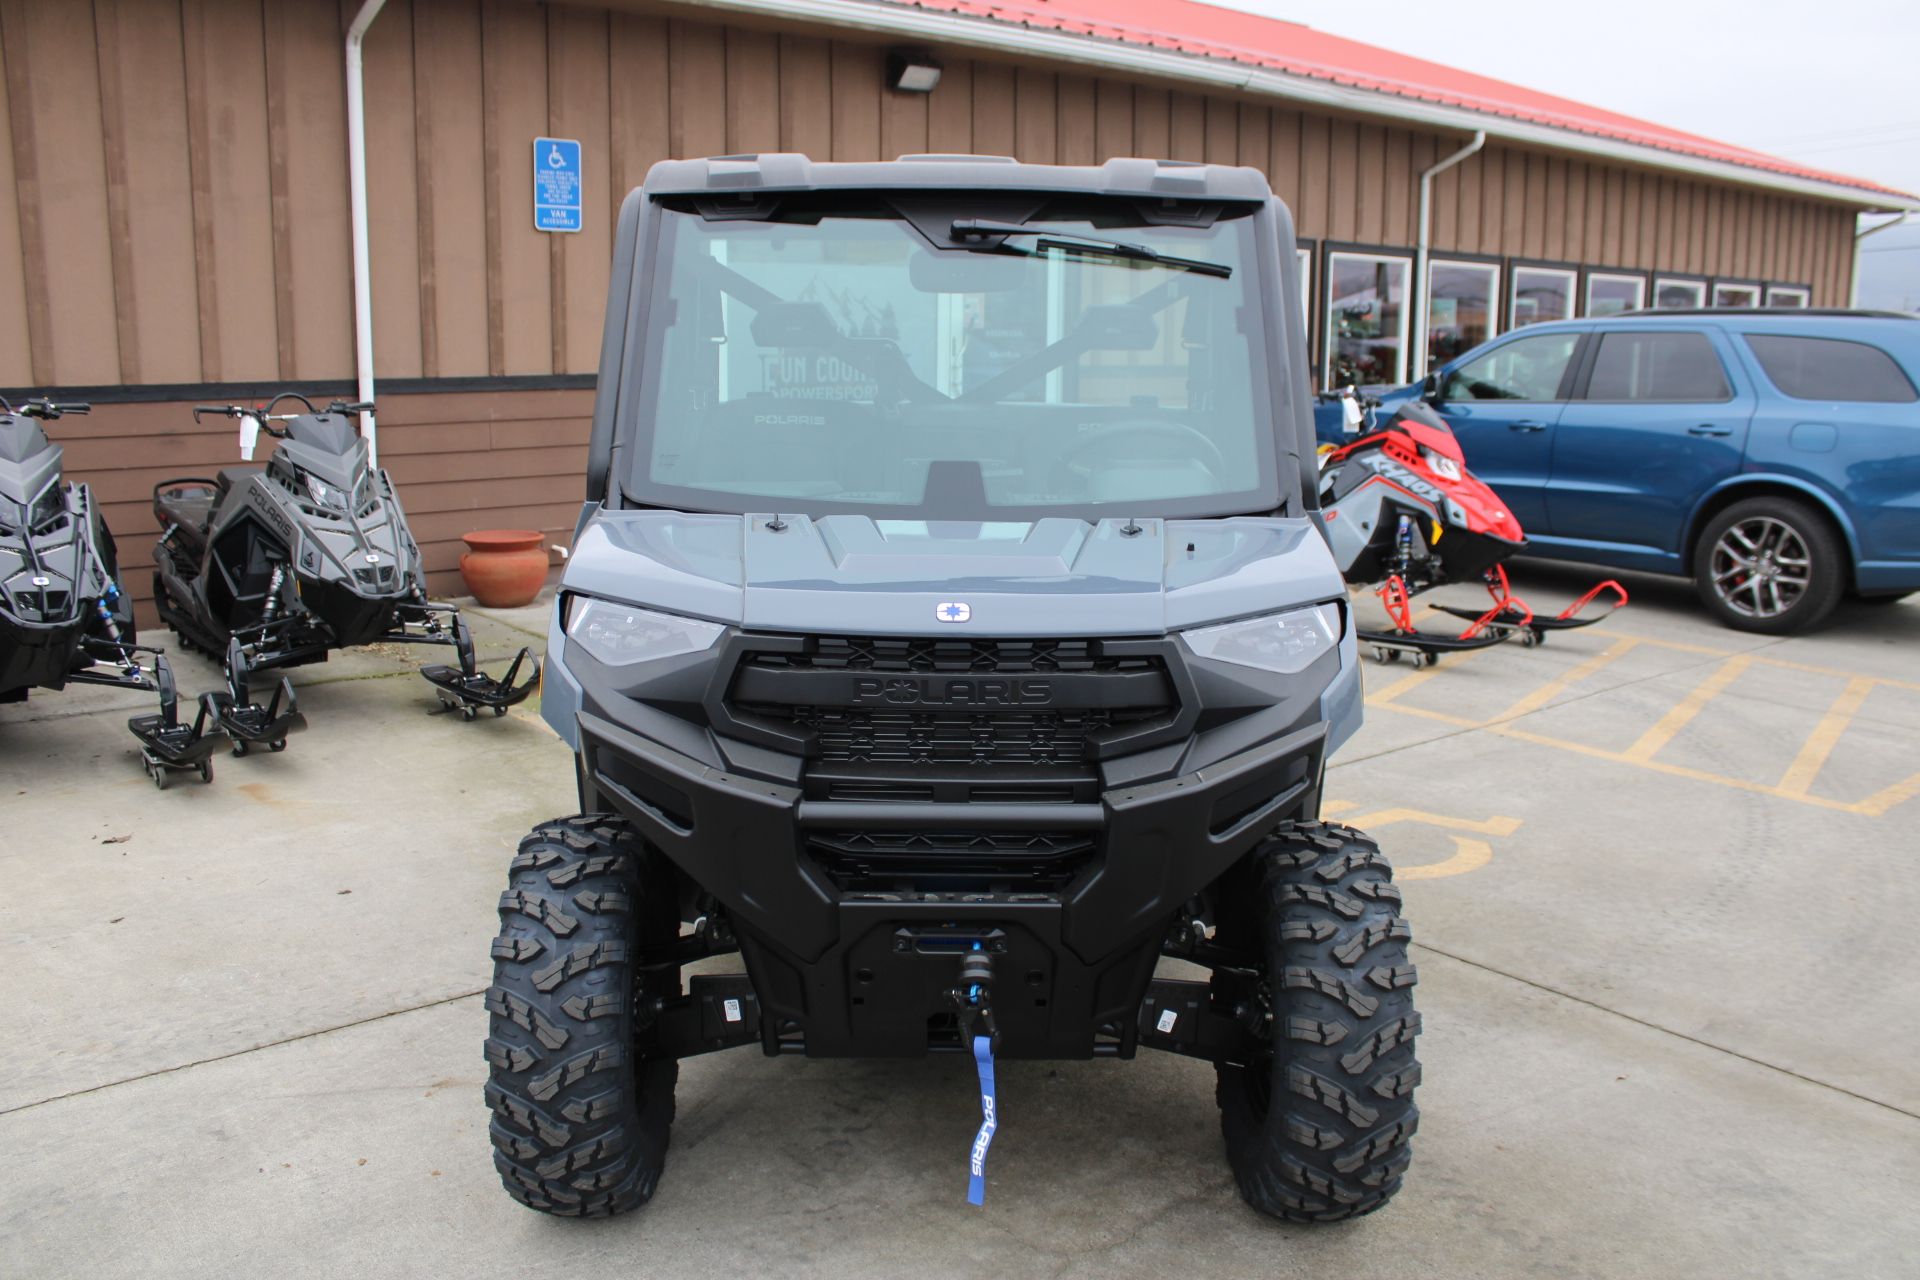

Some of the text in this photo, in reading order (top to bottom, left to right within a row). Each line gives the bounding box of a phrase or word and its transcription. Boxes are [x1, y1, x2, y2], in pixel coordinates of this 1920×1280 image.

[550, 209, 567, 218] VAN
[780, 386, 878, 400] POWERSPOR
[754, 415, 825, 425] POLARIS
[248, 485, 293, 537] POLARIS
[853, 678, 1053, 705] POLARIS
[972, 1094, 996, 1177] POLARIS
